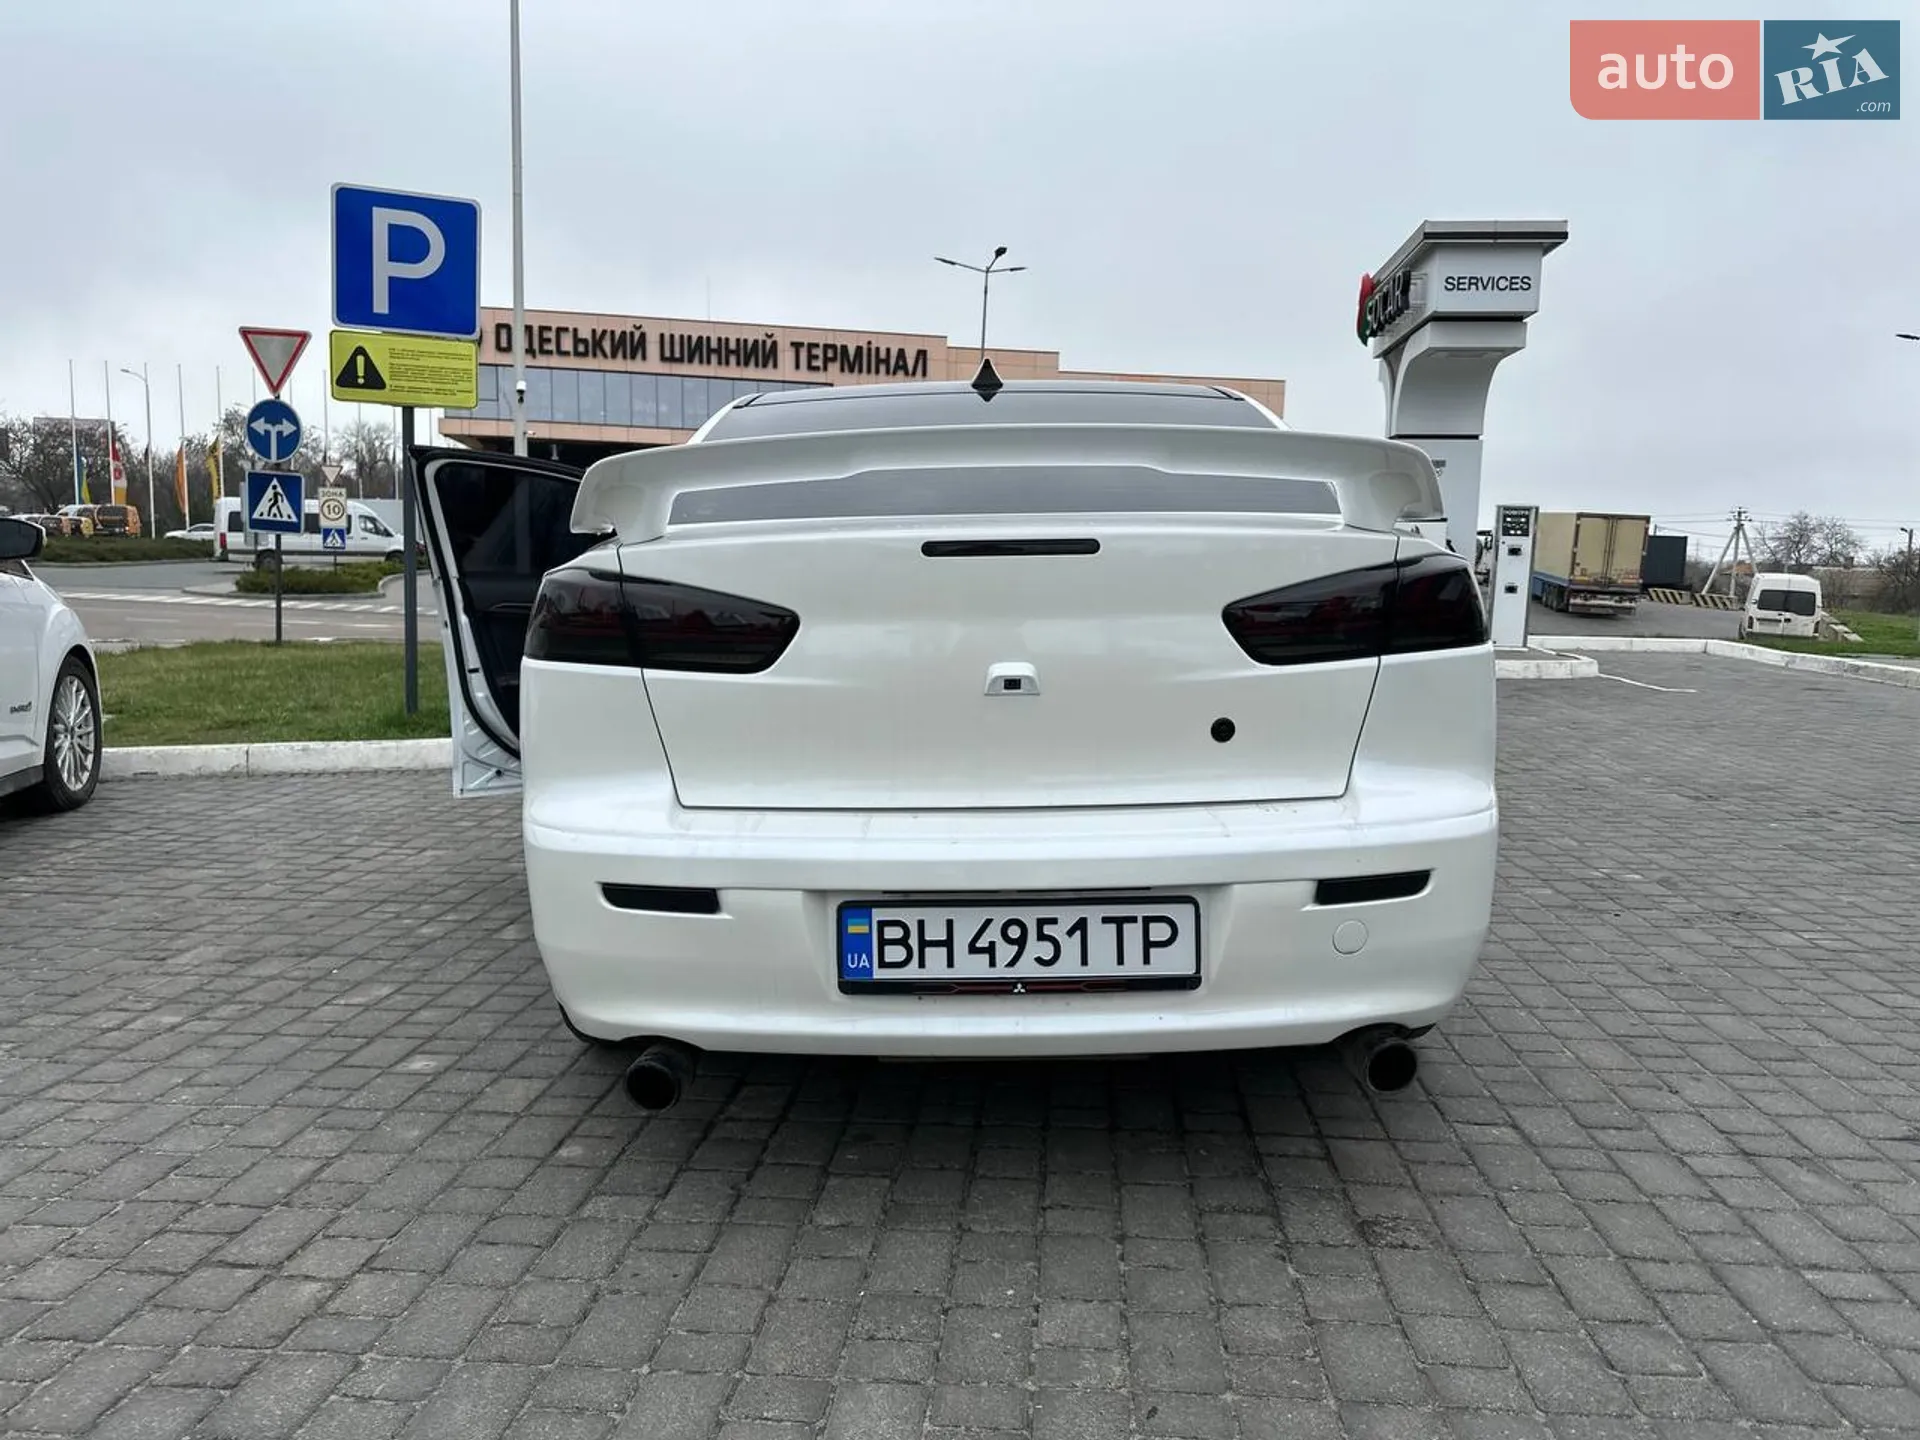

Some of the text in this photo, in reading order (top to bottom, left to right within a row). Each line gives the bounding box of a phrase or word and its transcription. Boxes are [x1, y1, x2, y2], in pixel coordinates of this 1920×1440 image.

[372, 205, 446, 315] P
[1443, 275, 1532, 292] SERVICES
[658, 332, 779, 370] ШИННИЙ
[326, 504, 341, 516] 10
[847, 953, 871, 970] UA
